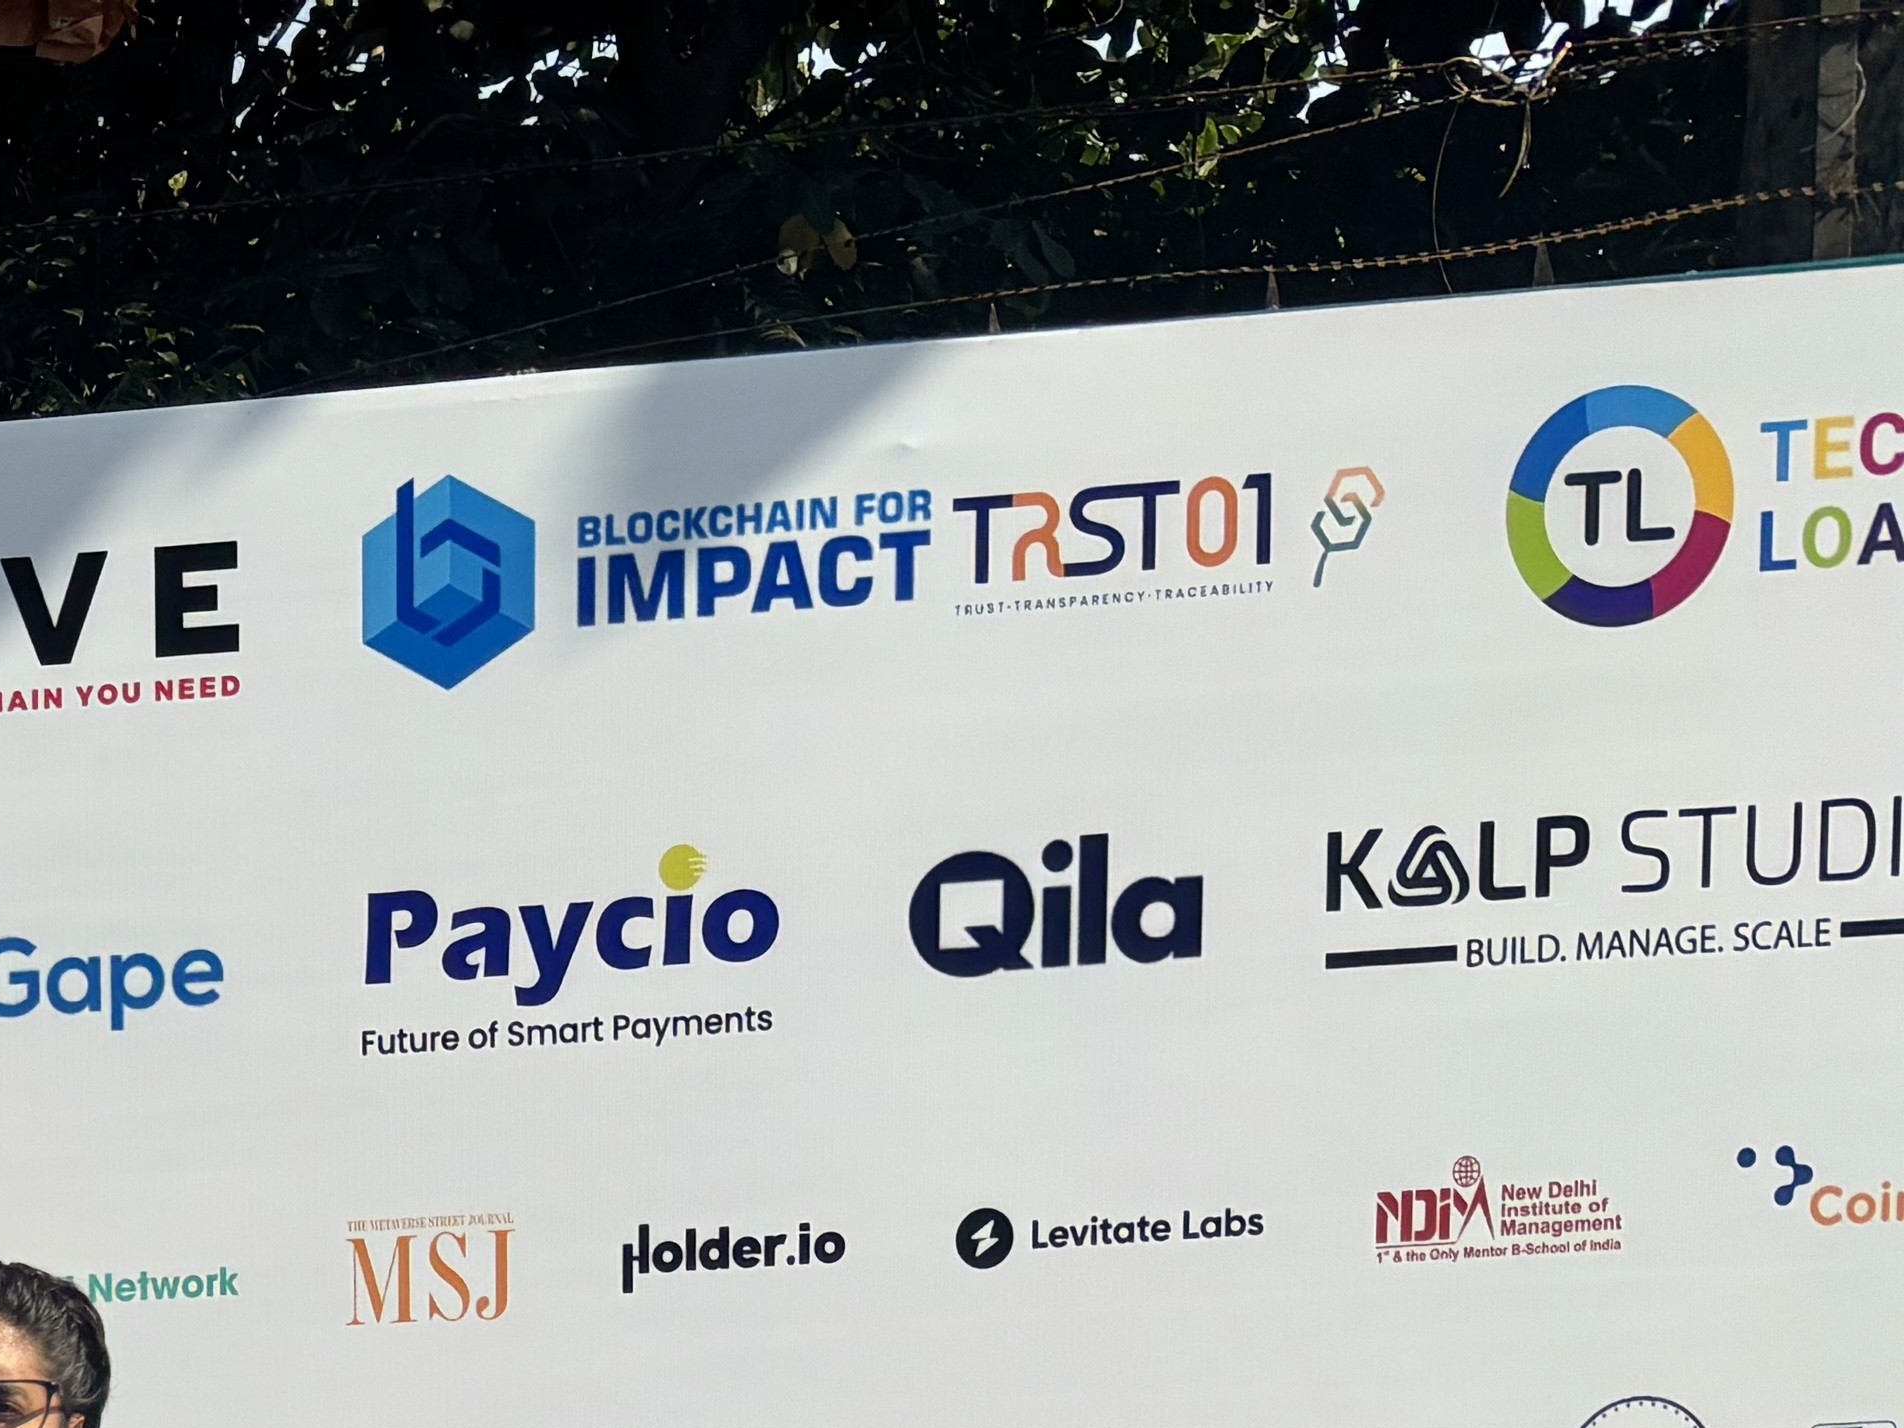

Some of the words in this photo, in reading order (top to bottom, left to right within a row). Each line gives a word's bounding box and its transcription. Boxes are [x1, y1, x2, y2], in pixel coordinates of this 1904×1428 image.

[577, 497, 837, 548] BLOCKCHAIN
[854, 489, 932, 525] FOR
[1565, 469, 1675, 545] TL
[577, 530, 930, 627] IMPACT
[75, 682, 142, 709] YOU
[154, 675, 241, 702] NEED
[365, 844, 780, 1007] Paycio
[909, 832, 1203, 978] Qila
[1466, 934, 1566, 968] BUILD.
[1576, 925, 1723, 962] MANAGE.
[1733, 917, 1832, 950] SCALE
[361, 1025, 459, 1056] Future
[468, 1020, 499, 1050] of
[507, 1016, 603, 1048] Smart
[613, 1006, 773, 1046] Payments
[1501, 1182, 1544, 1200] New
[1548, 1179, 1597, 1198] Delhi
[1501, 1198, 1581, 1218] Institute
[1588, 1197, 1608, 1214] of
[1032, 1214, 1171, 1250] Levitate
[1182, 1209, 1264, 1240] Labs
[1500, 1213, 1622, 1238] Management
[346, 1229, 515, 1326] MSJ
[622, 1222, 846, 1294] Holder.io
